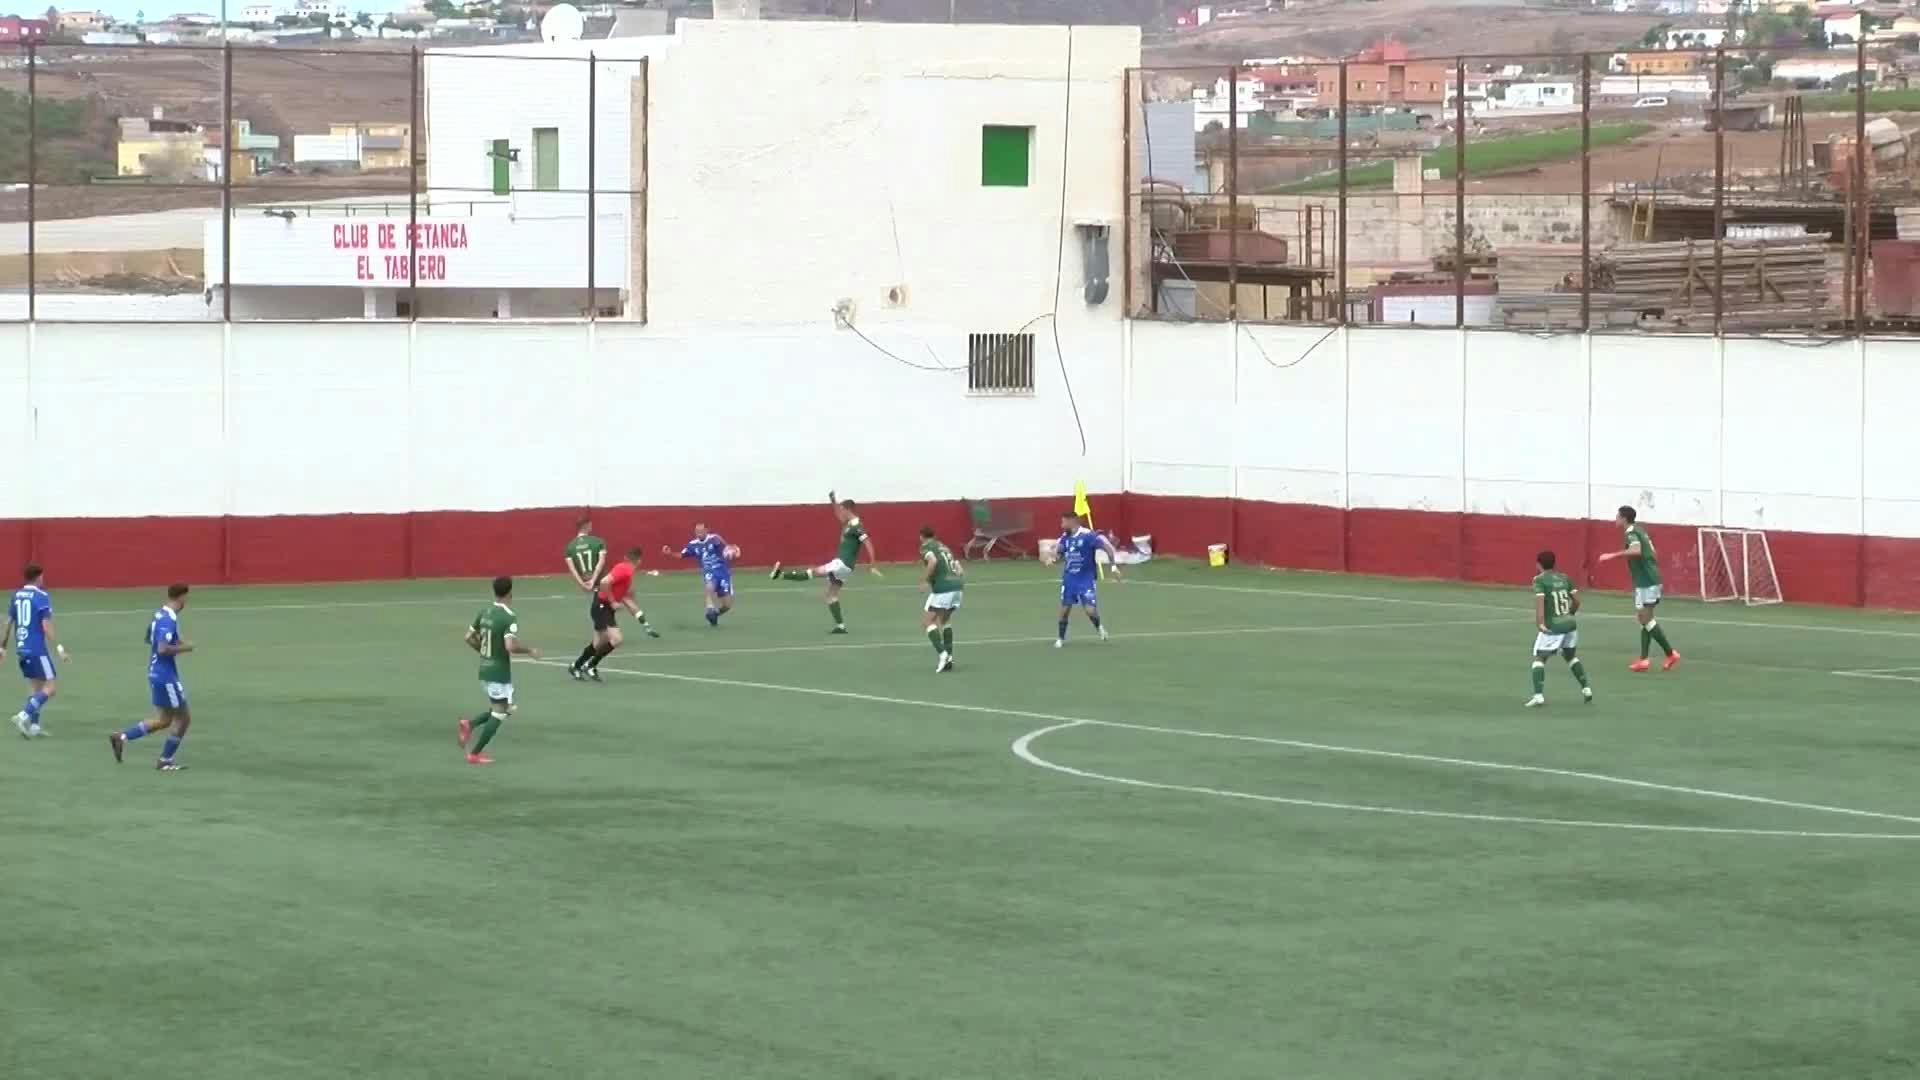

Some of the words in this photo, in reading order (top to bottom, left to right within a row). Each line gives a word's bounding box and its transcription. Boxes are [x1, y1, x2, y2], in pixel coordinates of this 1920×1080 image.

[333, 224, 368, 248] CLUB
[378, 224, 396, 248] DE
[357, 255, 374, 280] EL
[384, 255, 446, 280] TABERO
[576, 549, 593, 572] 17
[15, 599, 32, 627] 10
[1551, 590, 1569, 616] 15
